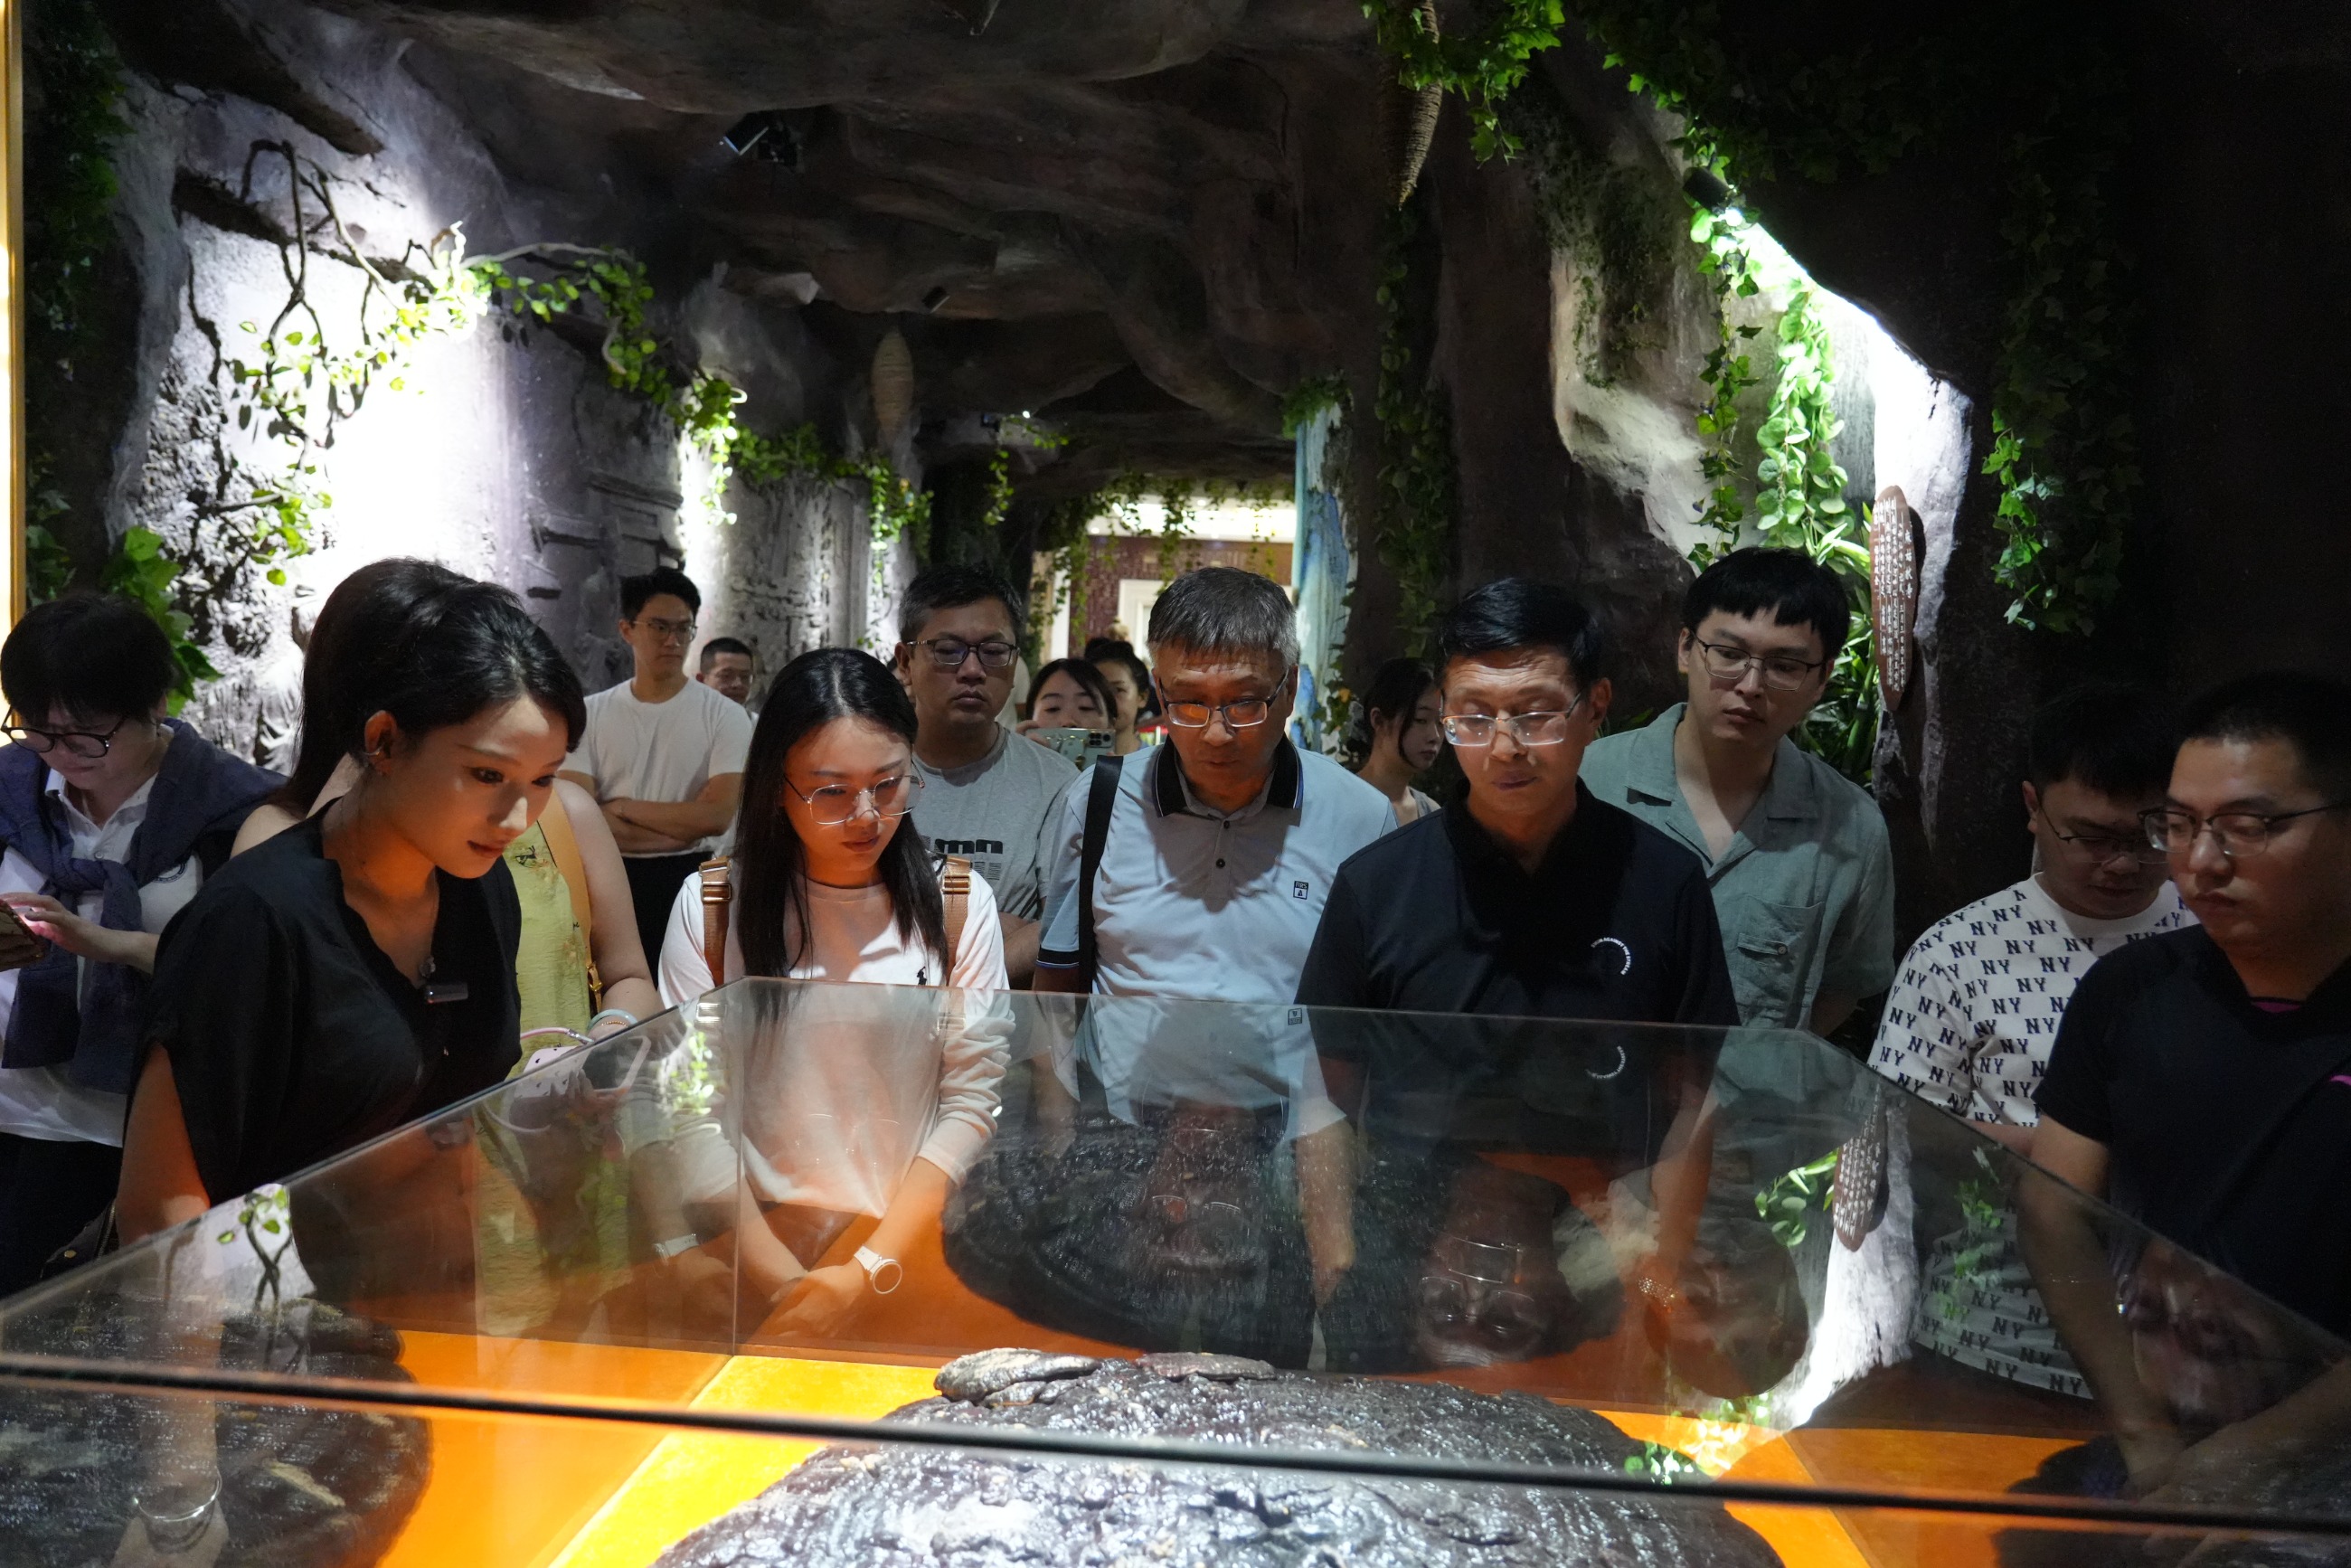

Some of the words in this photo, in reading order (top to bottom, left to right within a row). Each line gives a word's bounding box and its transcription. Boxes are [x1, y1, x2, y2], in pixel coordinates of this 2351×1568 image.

[1938, 912, 1965, 928] NY
[1992, 905, 2022, 921] NY
[1969, 921, 1998, 935] NY
[2026, 920, 2058, 935] NY
[1919, 930, 1943, 952] NY
[1950, 940, 1977, 958] NY
[2005, 940, 2035, 954] NY
[2063, 937, 2094, 951] NY
[1981, 959, 2010, 975] NY
[2040, 957, 2071, 972] NY
[1903, 968, 1927, 989] NY
[2016, 978, 2046, 992] NY
[1965, 978, 1989, 998] NY
[1918, 997, 1947, 1019] NY
[1992, 997, 2021, 1014] NY
[1889, 1006, 1917, 1029] NY
[2025, 1018, 2054, 1034] NY
[1974, 1019, 1997, 1037] NY
[1908, 1035, 1936, 1057] NY
[1939, 1027, 1967, 1051] NY
[2001, 1038, 2027, 1053] NY
[1880, 1046, 1904, 1065] NY
[1979, 1057, 2004, 1074] NY
[1898, 1072, 1925, 1092] NY
[1930, 1066, 1955, 1086] NY
[2003, 1081, 2031, 1098] NY
[1972, 1289, 2001, 1309] NY
[1993, 1317, 2024, 1339] NY
[1960, 1329, 1989, 1350] NY
[2021, 1346, 2053, 1365] NY
[1987, 1358, 2017, 1379] NY
[2049, 1374, 2082, 1394] NY
